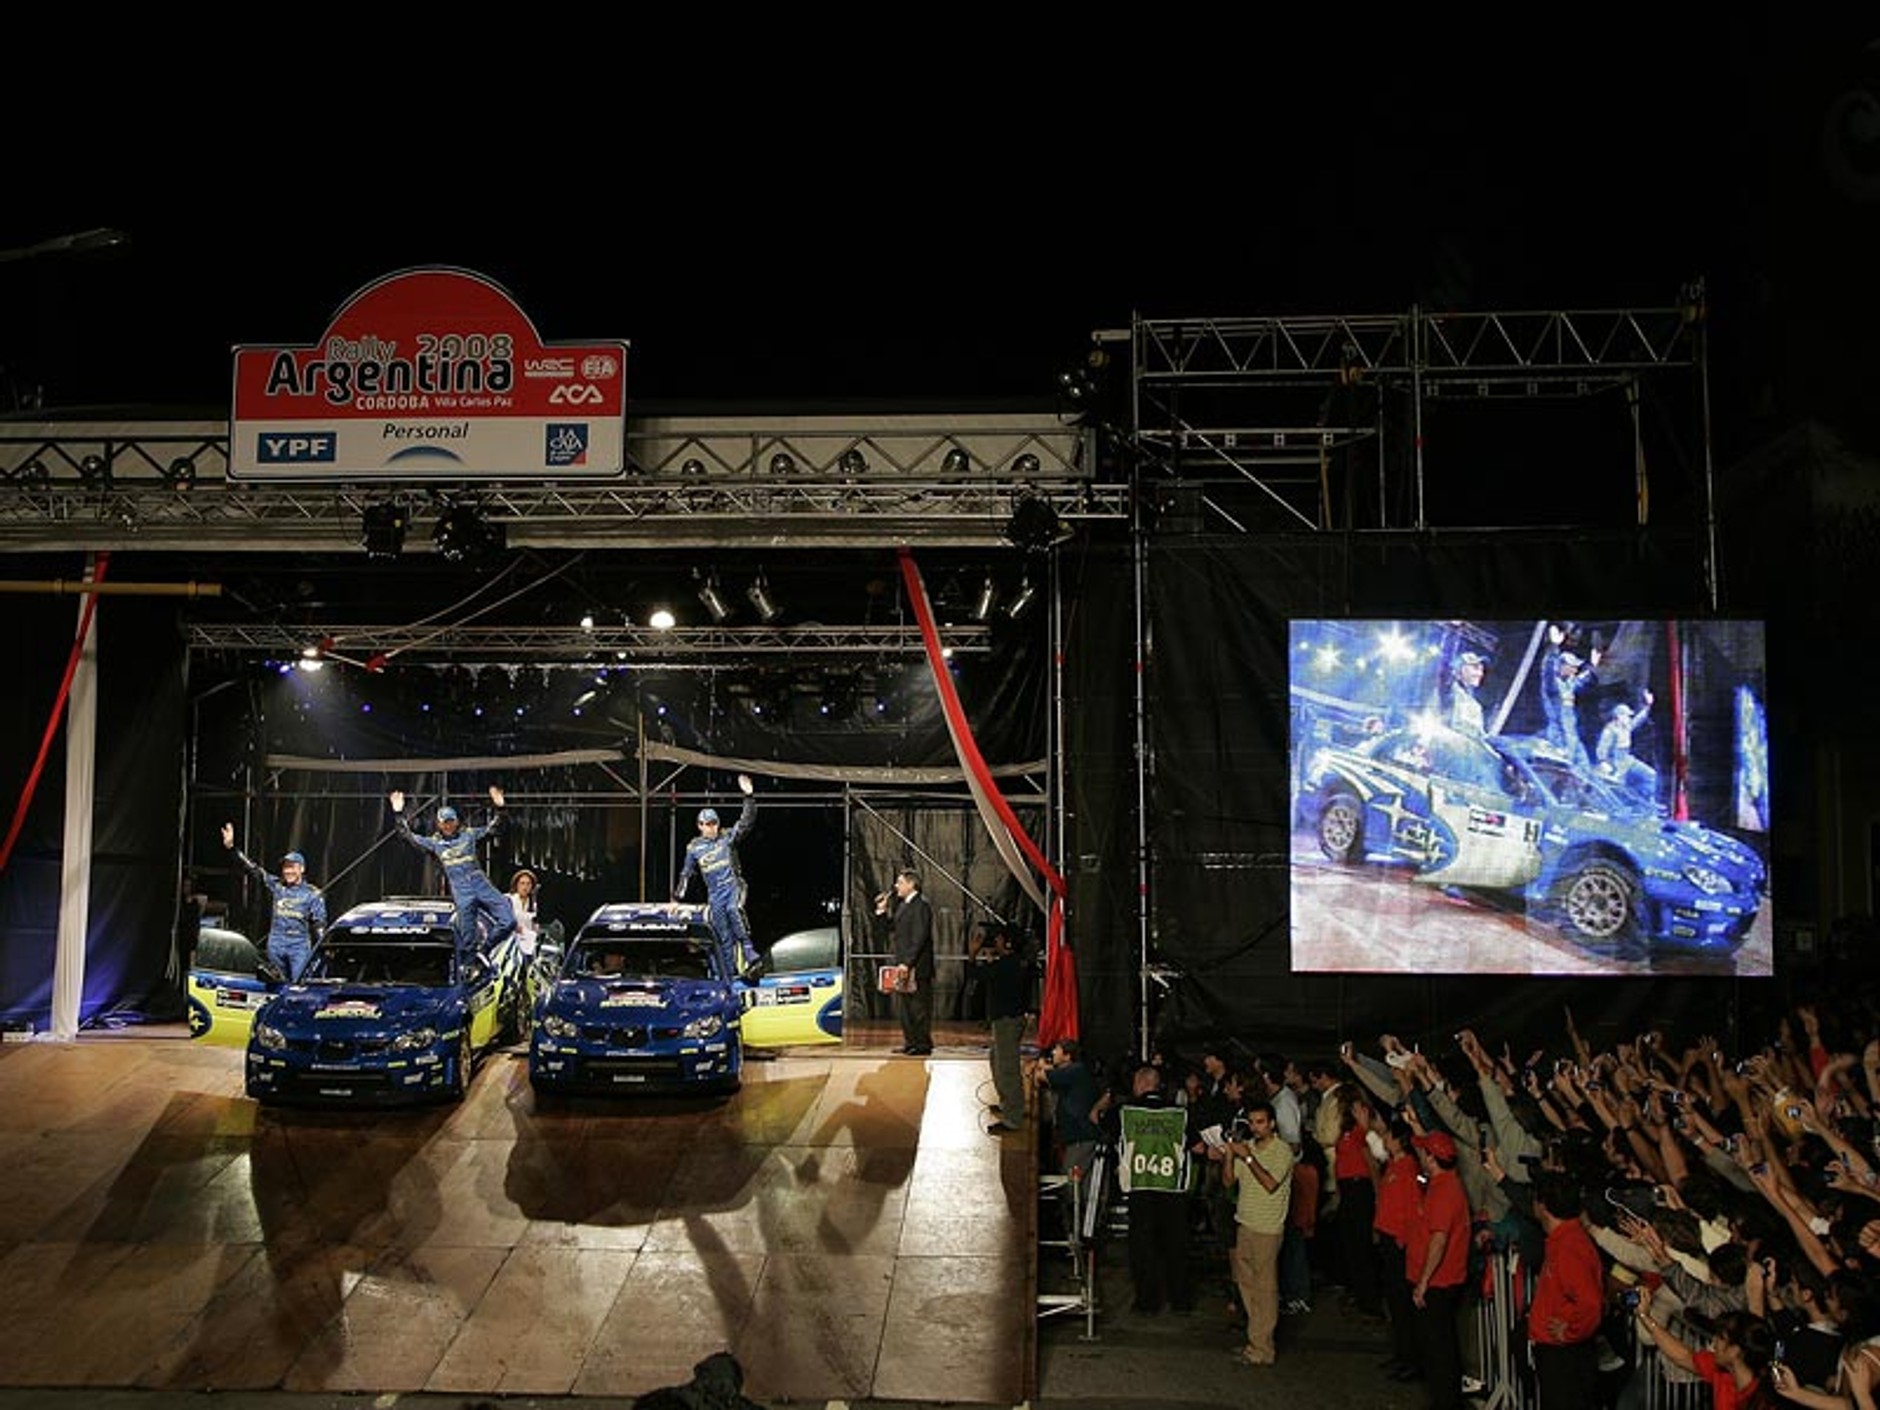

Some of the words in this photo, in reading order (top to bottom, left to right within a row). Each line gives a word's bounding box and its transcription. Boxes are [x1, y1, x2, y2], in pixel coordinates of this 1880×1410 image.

[327, 335, 397, 362] Rally
[416, 332, 514, 361] 2008
[524, 357, 575, 371] WRC
[265, 348, 514, 406] Argentina
[356, 395, 429, 410] CORDOBA
[434, 396, 457, 407] Villa
[459, 396, 492, 407] Carlos
[548, 384, 604, 405] ACA
[383, 421, 469, 439] Personal
[265, 438, 329, 457] YPF
[1134, 1154, 1174, 1177] 048
